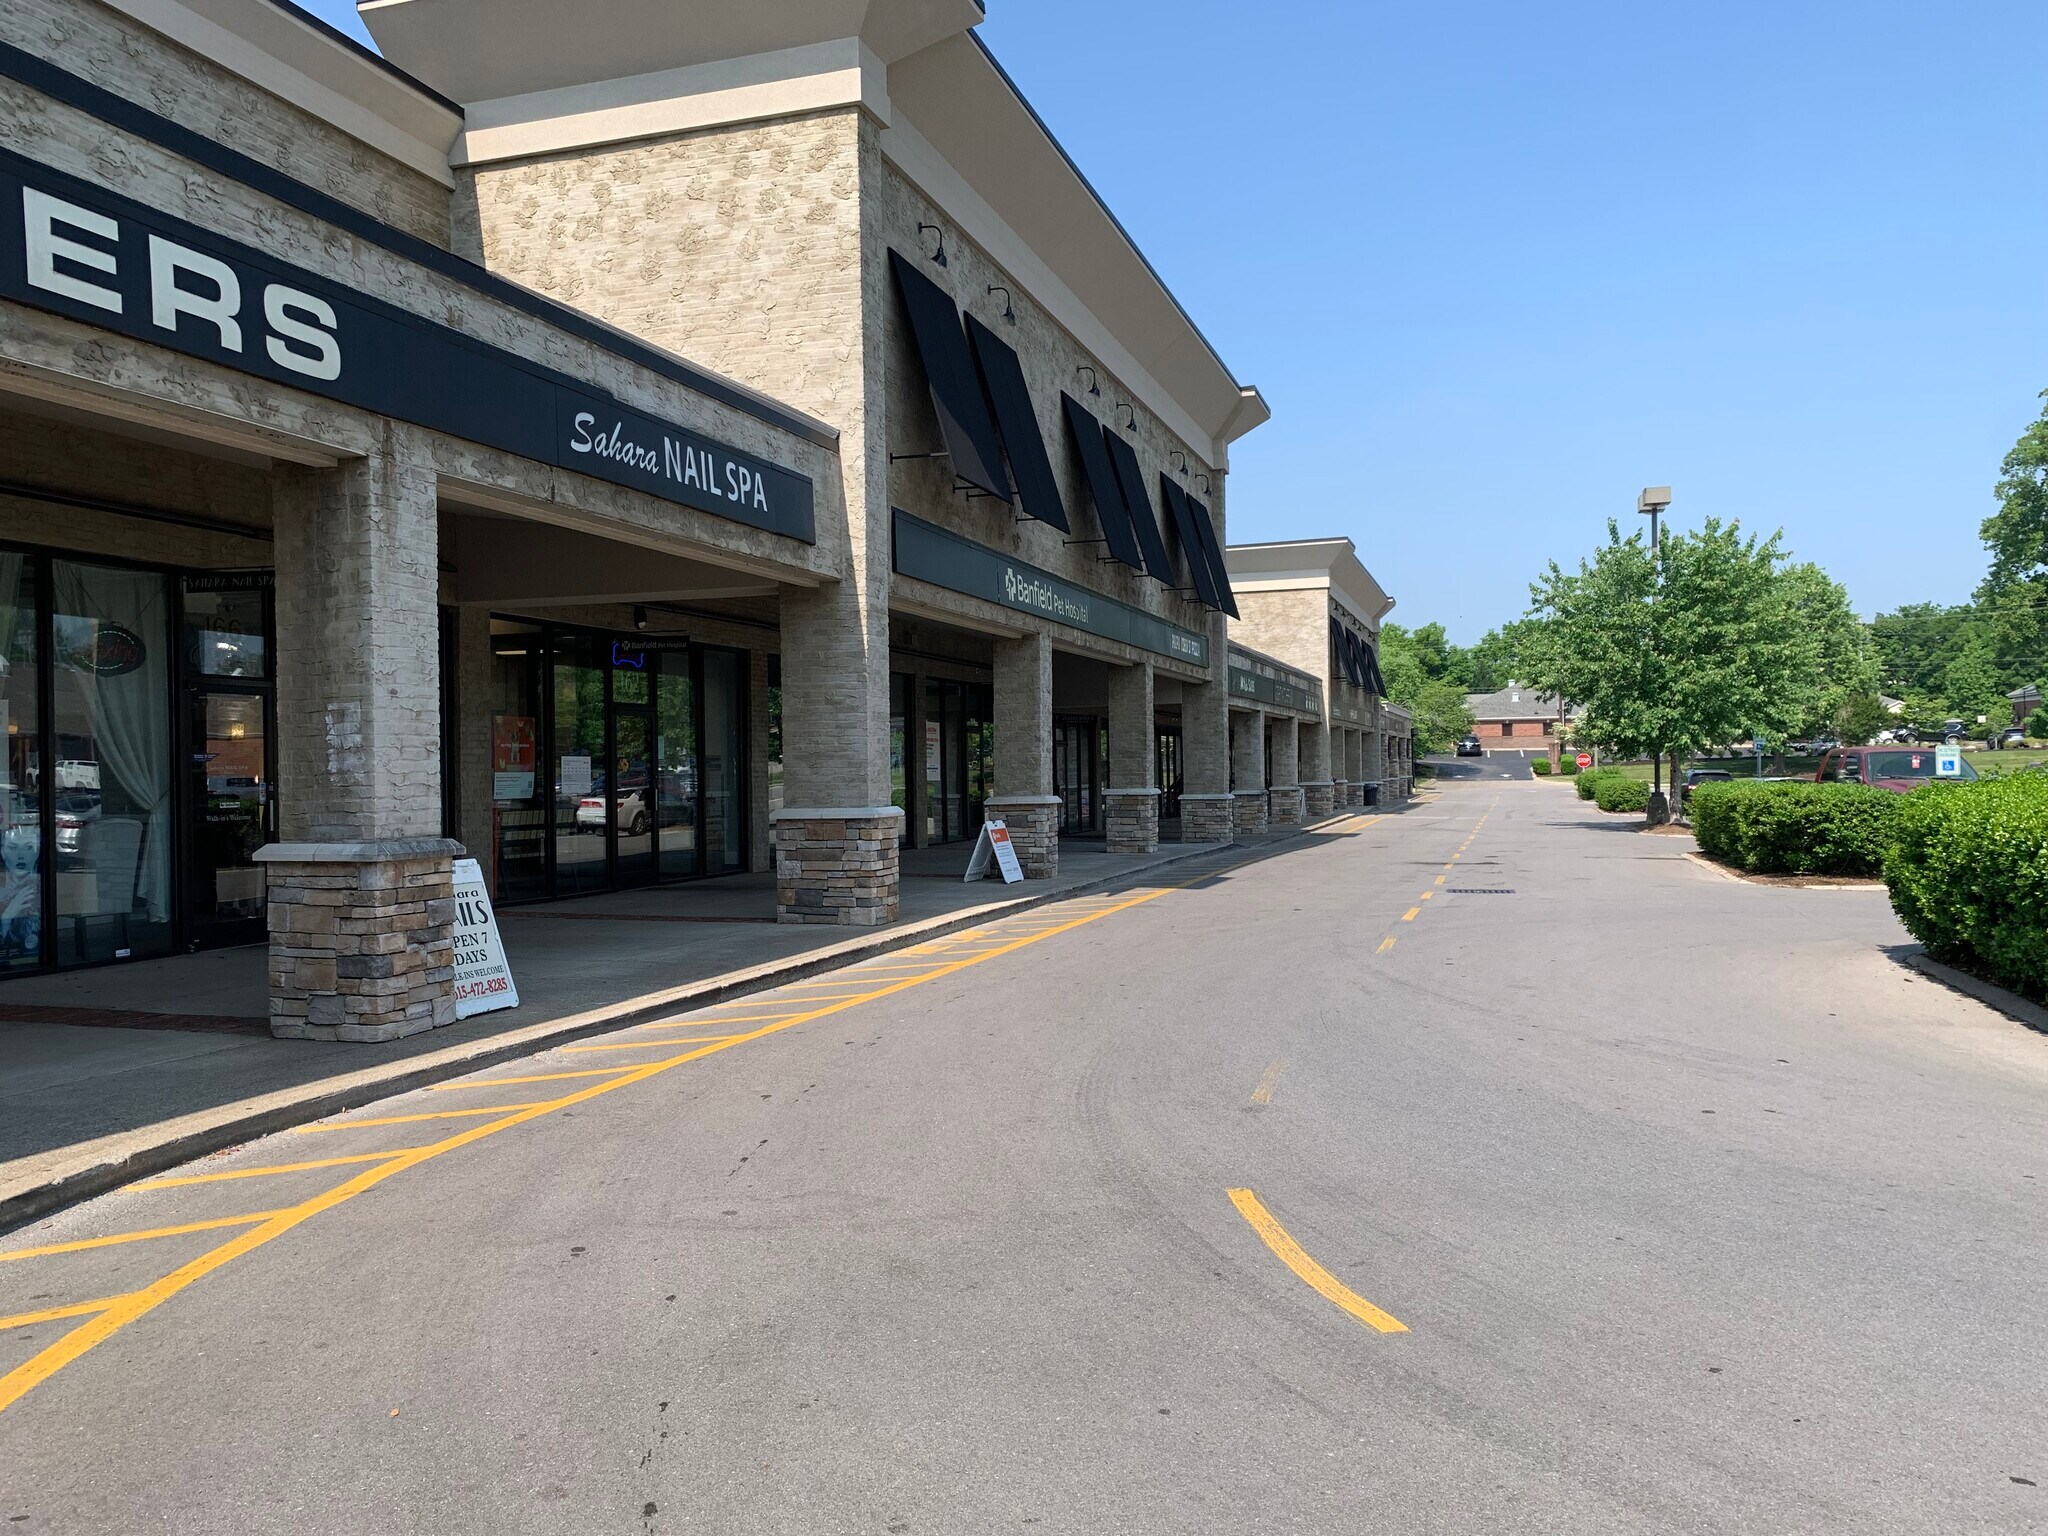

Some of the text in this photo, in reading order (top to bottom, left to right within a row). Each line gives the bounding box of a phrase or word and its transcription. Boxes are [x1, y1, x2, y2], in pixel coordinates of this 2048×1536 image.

[22, 185, 342, 382] ERS
[570, 411, 769, 512] Sahara NAIL SPA
[188, 577, 228, 589] SAHARA
[232, 576, 253, 587] NAIL
[1016, 574, 1089, 625] Banfield Pet Hospital
[631, 641, 657, 650] Banfield
[667, 641, 687, 650] Hospital
[453, 890, 479, 899] ara
[455, 900, 489, 927] ILS
[453, 932, 487, 948] PEN 7
[454, 949, 488, 966] DAYS
[474, 965, 504, 977] WELCOME
